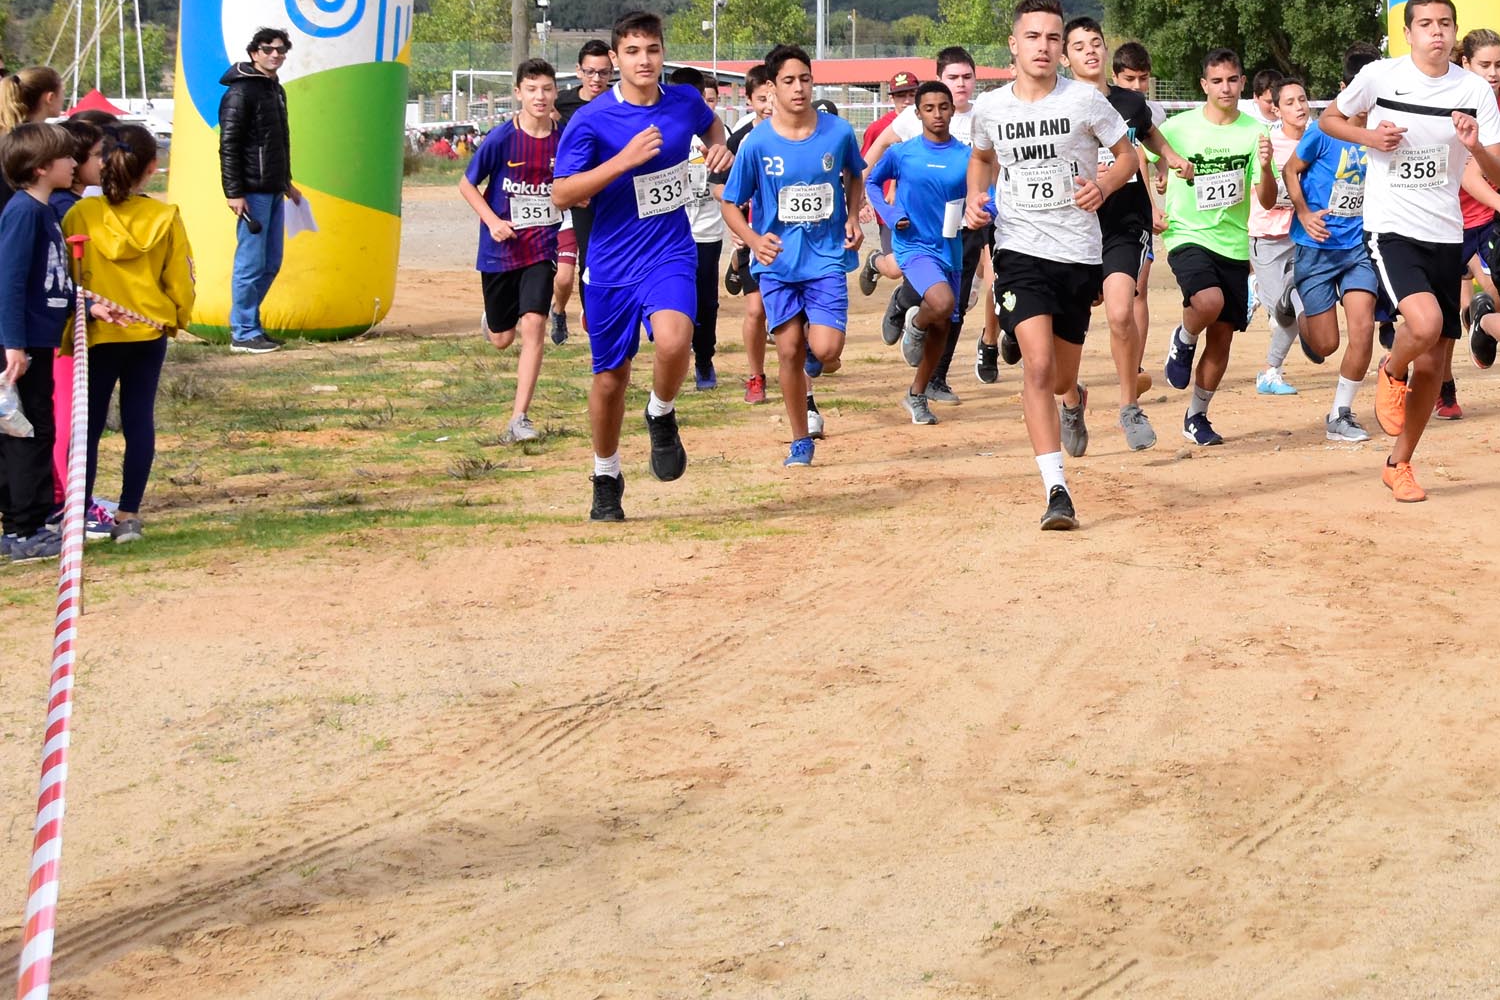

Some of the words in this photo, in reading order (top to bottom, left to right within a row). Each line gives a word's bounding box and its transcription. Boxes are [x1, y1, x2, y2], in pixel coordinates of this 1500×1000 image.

[998, 124, 1003, 140] I
[1006, 121, 1036, 140] CAN
[1039, 118, 1071, 136] AND
[1013, 147, 1019, 162] I
[1021, 143, 1057, 160] WILL
[763, 156, 784, 176] 23
[1400, 161, 1436, 179] 358
[502, 177, 553, 195] Rakute
[654, 176, 677, 186] ESCOLAR
[649, 180, 682, 205] 333
[1027, 182, 1054, 199] 78
[1206, 183, 1236, 200] 212
[643, 205, 670, 216] SANTIAGO
[790, 197, 822, 212] 363
[1338, 195, 1364, 210] 289
[521, 206, 551, 219] 351
